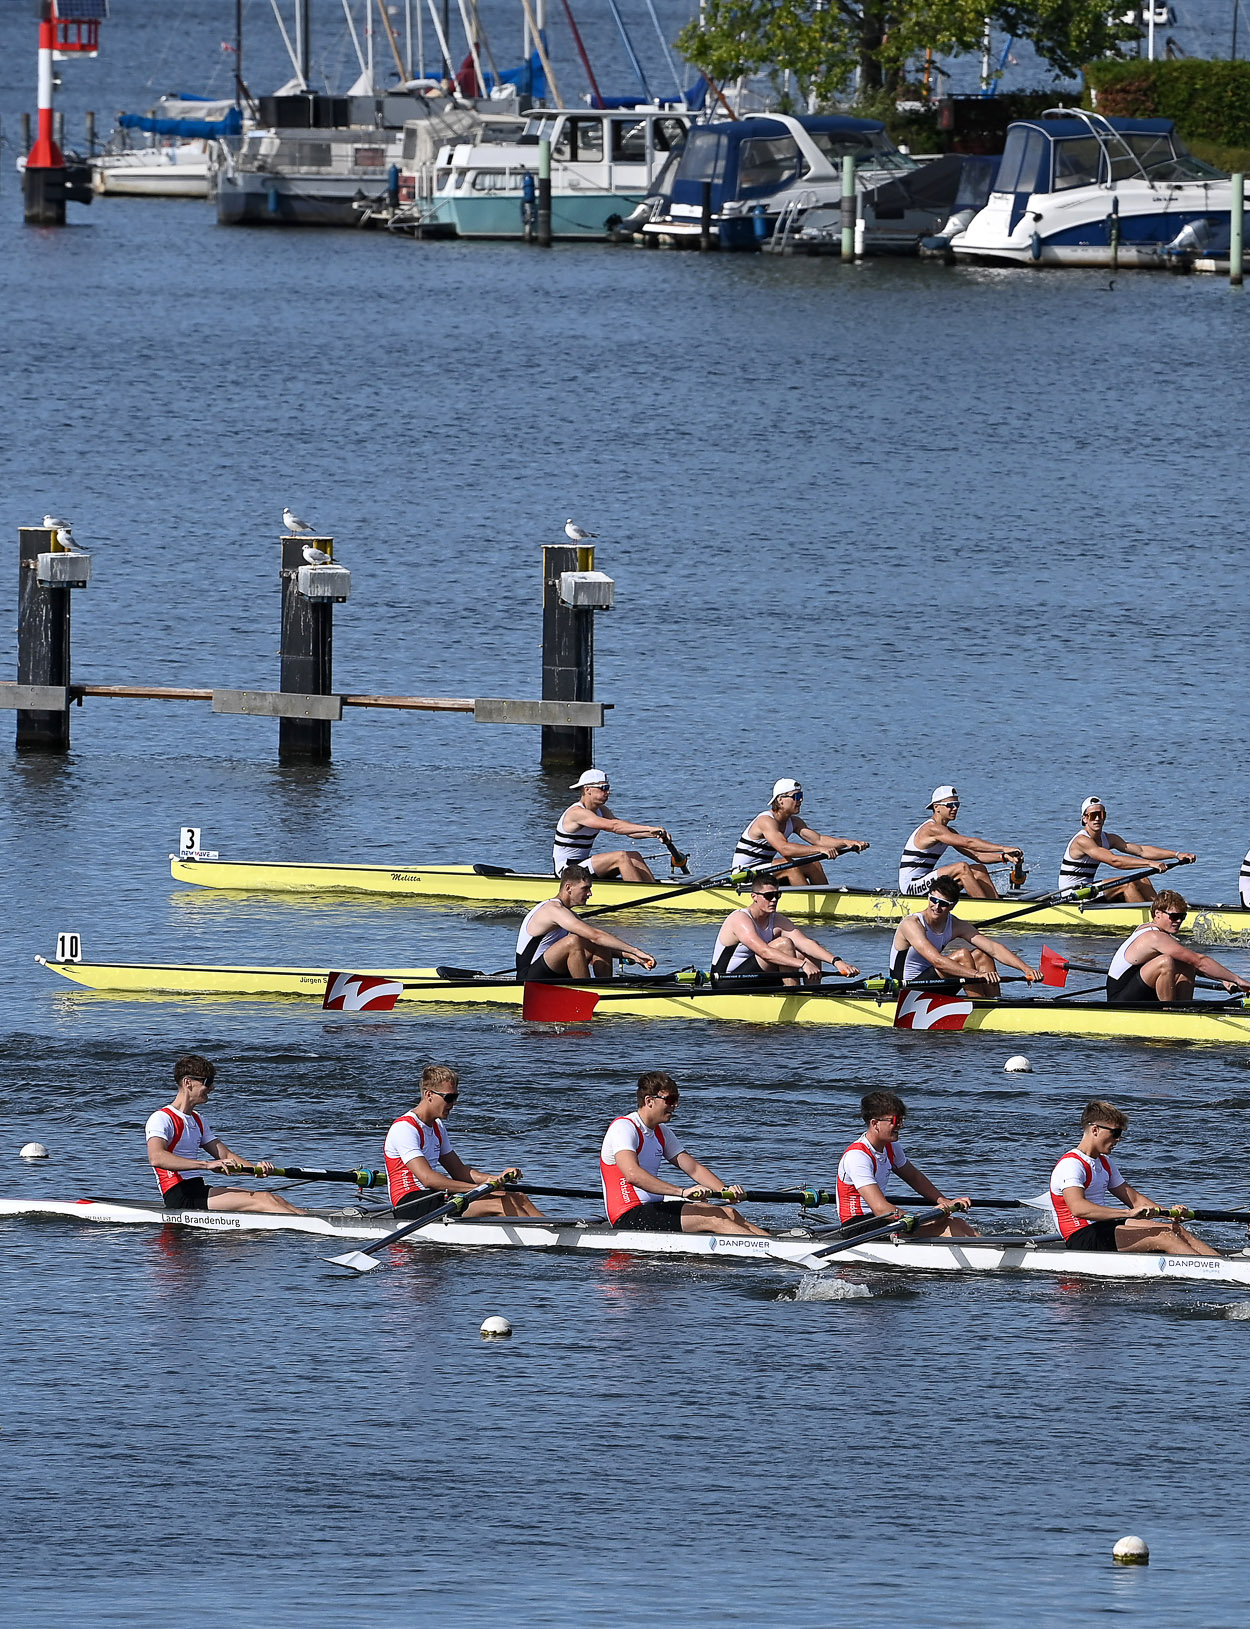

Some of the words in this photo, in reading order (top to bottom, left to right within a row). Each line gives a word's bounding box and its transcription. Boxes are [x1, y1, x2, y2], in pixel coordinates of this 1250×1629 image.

[186, 829, 195, 849] 3
[391, 873, 421, 881] Melitta
[60, 935, 78, 957] 10
[162, 1213, 182, 1222] Land
[185, 1215, 241, 1227] Brandenburg
[719, 1240, 770, 1248] DANPOWER
[1168, 1260, 1220, 1268] DANPOWER
